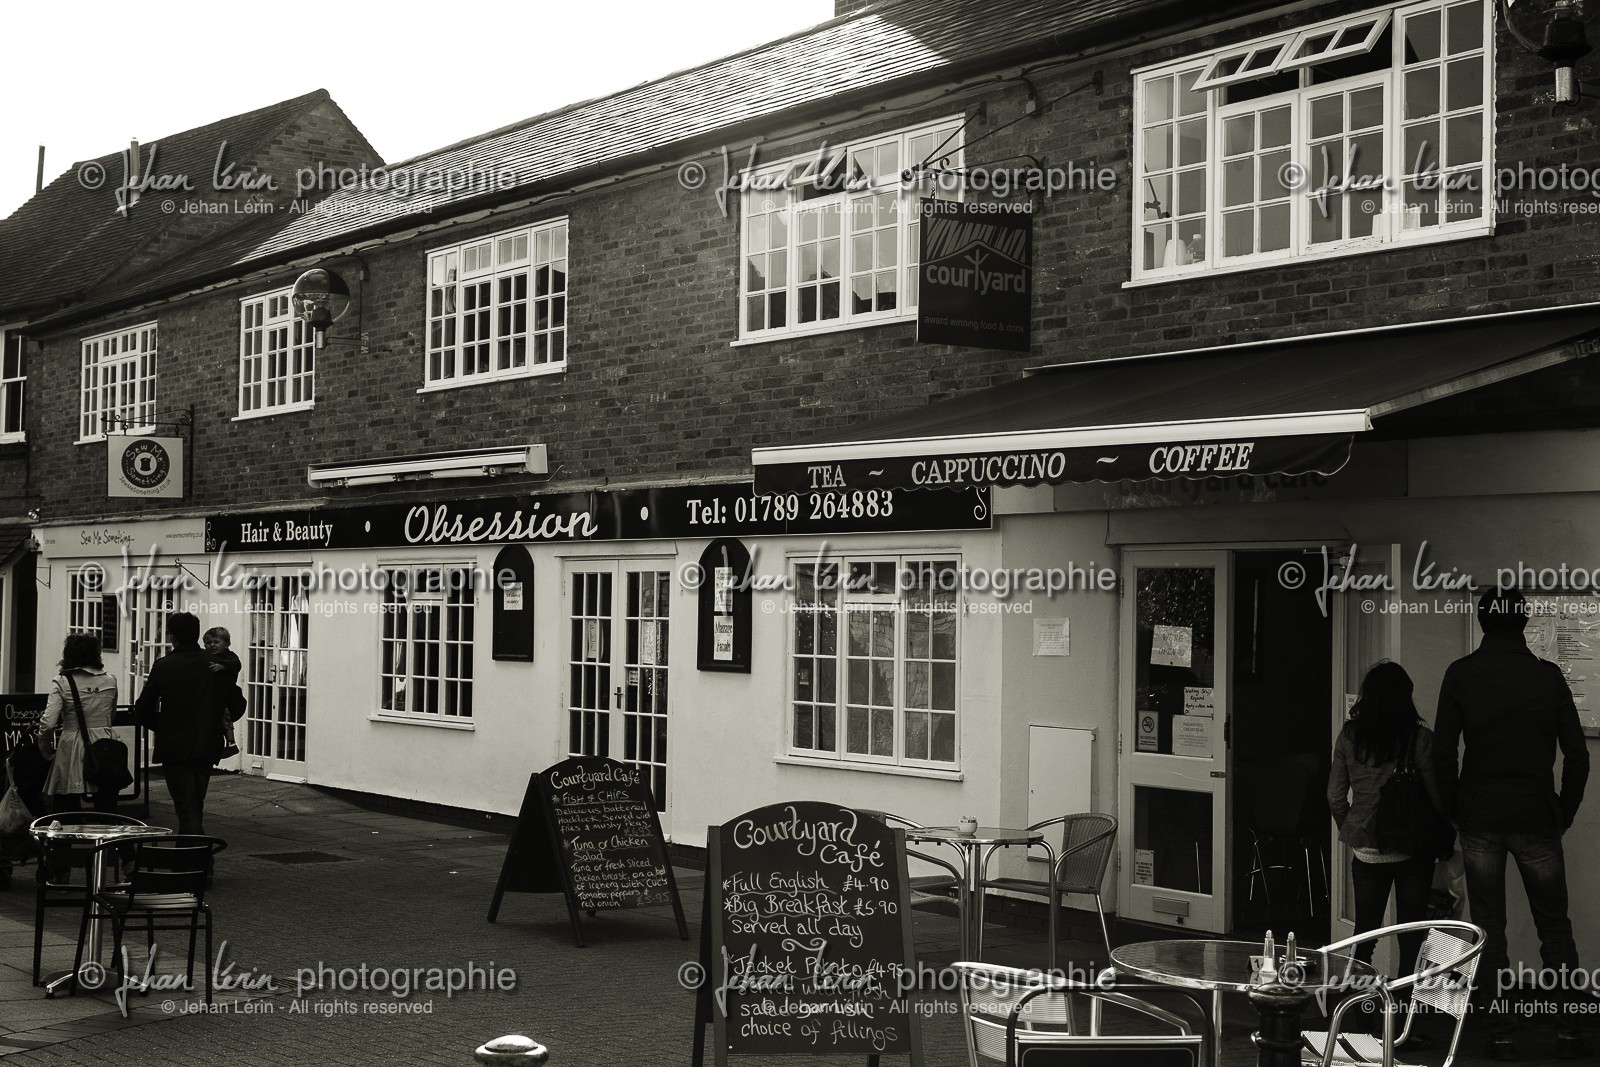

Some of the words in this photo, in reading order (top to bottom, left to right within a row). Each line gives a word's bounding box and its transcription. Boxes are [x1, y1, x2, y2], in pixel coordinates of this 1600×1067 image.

[926, 250, 1026, 295] courtyard
[924, 316, 948, 326] award
[950, 318, 979, 331] winning
[980, 320, 997, 331] food
[1007, 323, 1024, 333] drink
[126, 444, 148, 460] Sew
[150, 444, 163, 462] Me
[807, 465, 847, 489] TEA
[911, 452, 1066, 486] CAPPUCCINO
[1148, 442, 1255, 474] COFFEE
[126, 467, 167, 485] Something
[241, 521, 270, 543] Hair
[272, 521, 282, 542] &
[285, 519, 333, 547] Beauty
[404, 502, 598, 543] Obsession
[686, 499, 727, 525] Tel:
[734, 494, 799, 523] 01789
[809, 489, 894, 520] 264883
[81, 530, 92, 545] Sew
[93, 531, 101, 545] Me
[551, 763, 612, 790] Courtyard
[614, 768, 641, 787] Café
[554, 806, 602, 816] Delicious
[603, 801, 648, 813] battered
[560, 824, 581, 834] fries
[592, 822, 622, 831] mushy
[733, 805, 858, 856] Courtyard
[571, 836, 596, 850] Tuna
[598, 840, 608, 850] or
[611, 835, 649, 848] Chicken
[573, 849, 606, 861] Salad
[820, 839, 884, 873] Café
[570, 862, 591, 873] Tuna
[593, 864, 603, 872] or
[605, 859, 625, 871] fresh
[576, 882, 585, 891] of
[621, 879, 645, 888] with
[730, 870, 763, 891] Full
[769, 871, 830, 898] English
[842, 874, 889, 892] £4.90
[581, 898, 596, 908] red
[597, 900, 621, 908] onion
[610, 889, 641, 902] peppers
[731, 894, 759, 923] Big
[763, 893, 851, 921] Breakfast
[853, 897, 898, 917] £5.90
[732, 916, 791, 935] Served
[797, 917, 820, 935] all
[828, 917, 863, 947] day
[733, 955, 797, 974] Jacket
[805, 956, 863, 977] Potato
[865, 958, 903, 979] £4.95
[1254, 959, 1260, 968] 1
[802, 979, 842, 996] with
[741, 1017, 793, 1038] choice
[801, 1019, 822, 1045] of
[830, 1019, 898, 1051] fillings
